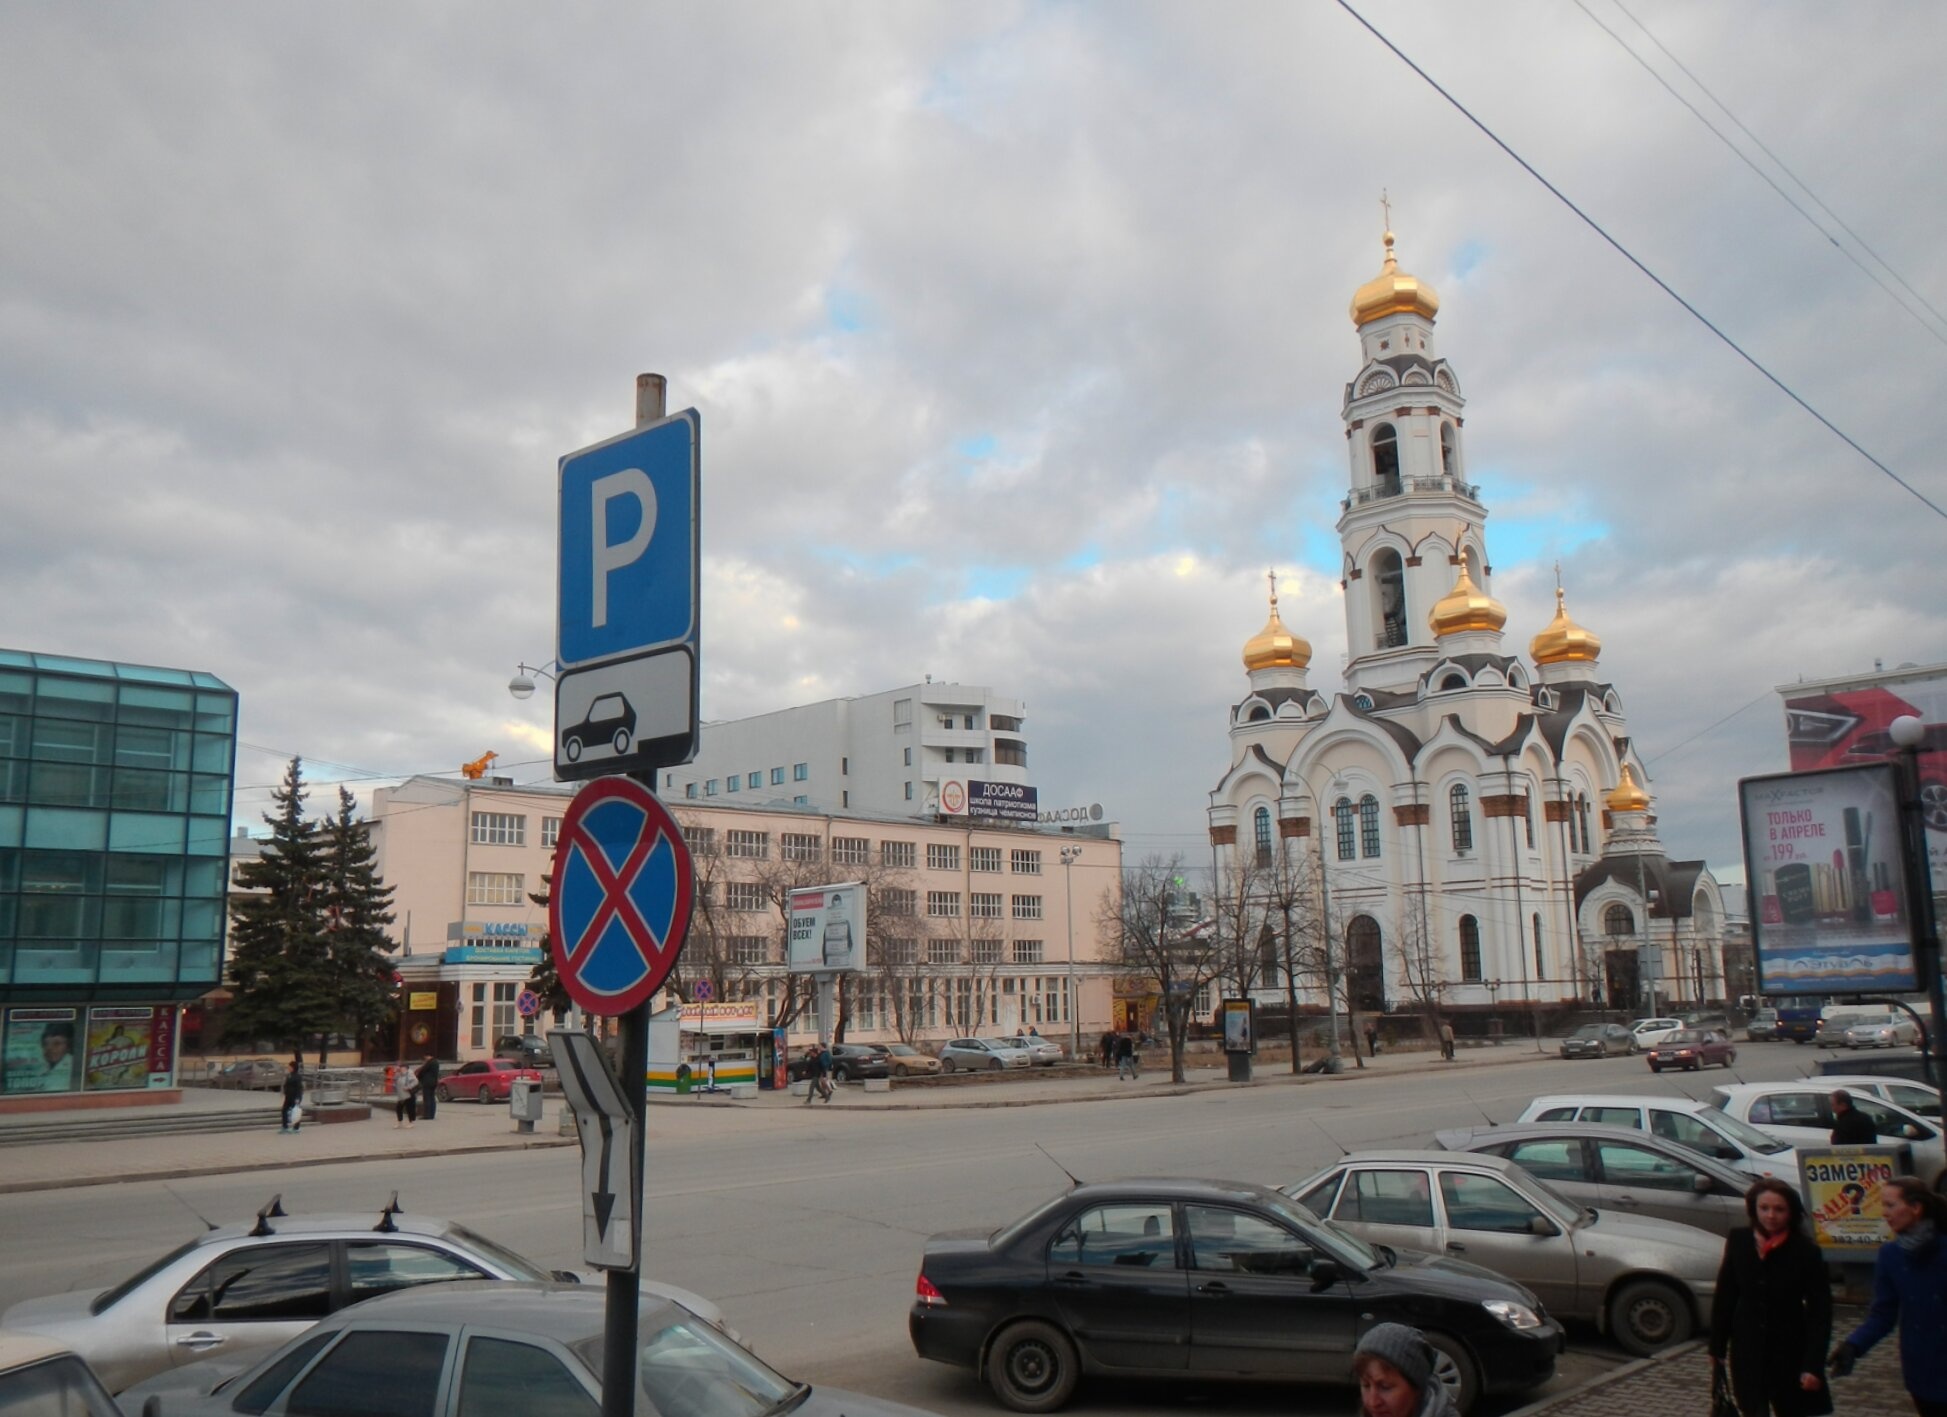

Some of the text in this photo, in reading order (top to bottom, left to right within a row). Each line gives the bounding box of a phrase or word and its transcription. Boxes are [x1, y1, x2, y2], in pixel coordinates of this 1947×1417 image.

[592, 468, 658, 629] P
[983, 783, 1024, 798] ДОСААФ
[969, 797, 992, 807] школа
[969, 806, 998, 817] кузница
[1767, 808, 1812, 826] ТОЛЬКО
[1769, 823, 1826, 841] В АПРЕЛЕ
[1771, 843, 1794, 861] 199
[484, 922, 528, 937] КАССЫ
[793, 917, 816, 929] ОБУЕМ
[793, 929, 812, 940] ВСЕХ!
[156, 1008, 168, 1070] КАССА
